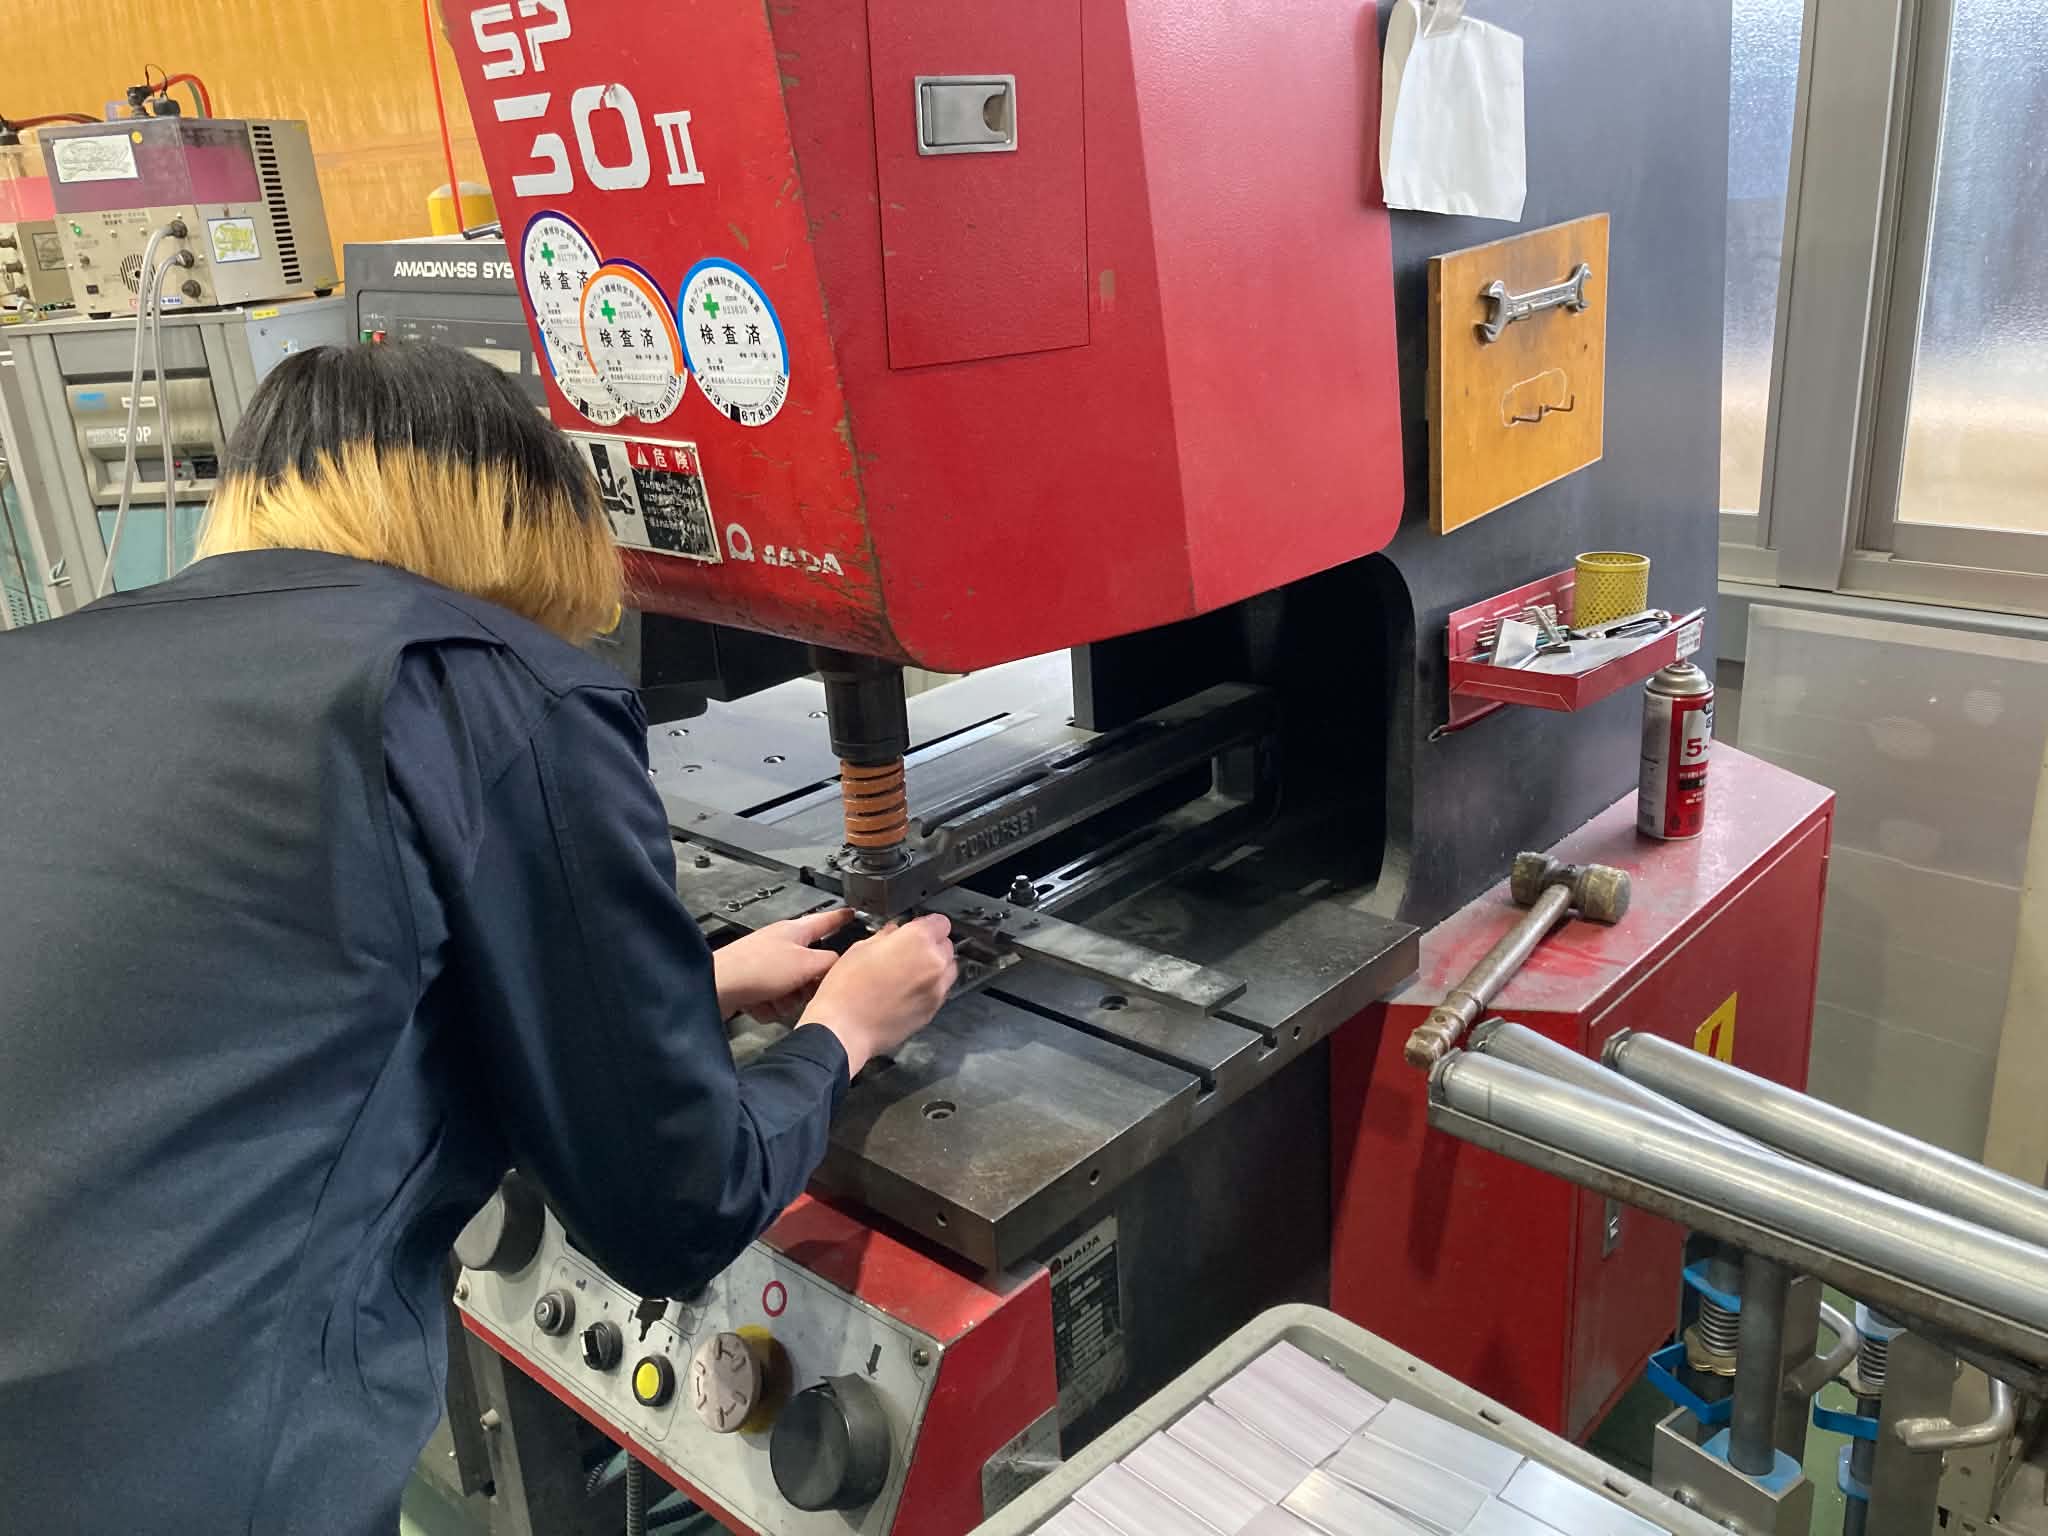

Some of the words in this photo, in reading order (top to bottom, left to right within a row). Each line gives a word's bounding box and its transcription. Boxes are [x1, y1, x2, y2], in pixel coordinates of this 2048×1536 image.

[471, 0, 571, 80] SP
[599, 327, 655, 348] 検査済
[700, 323, 761, 345] 検査済
[118, 426, 152, 444] 50P
